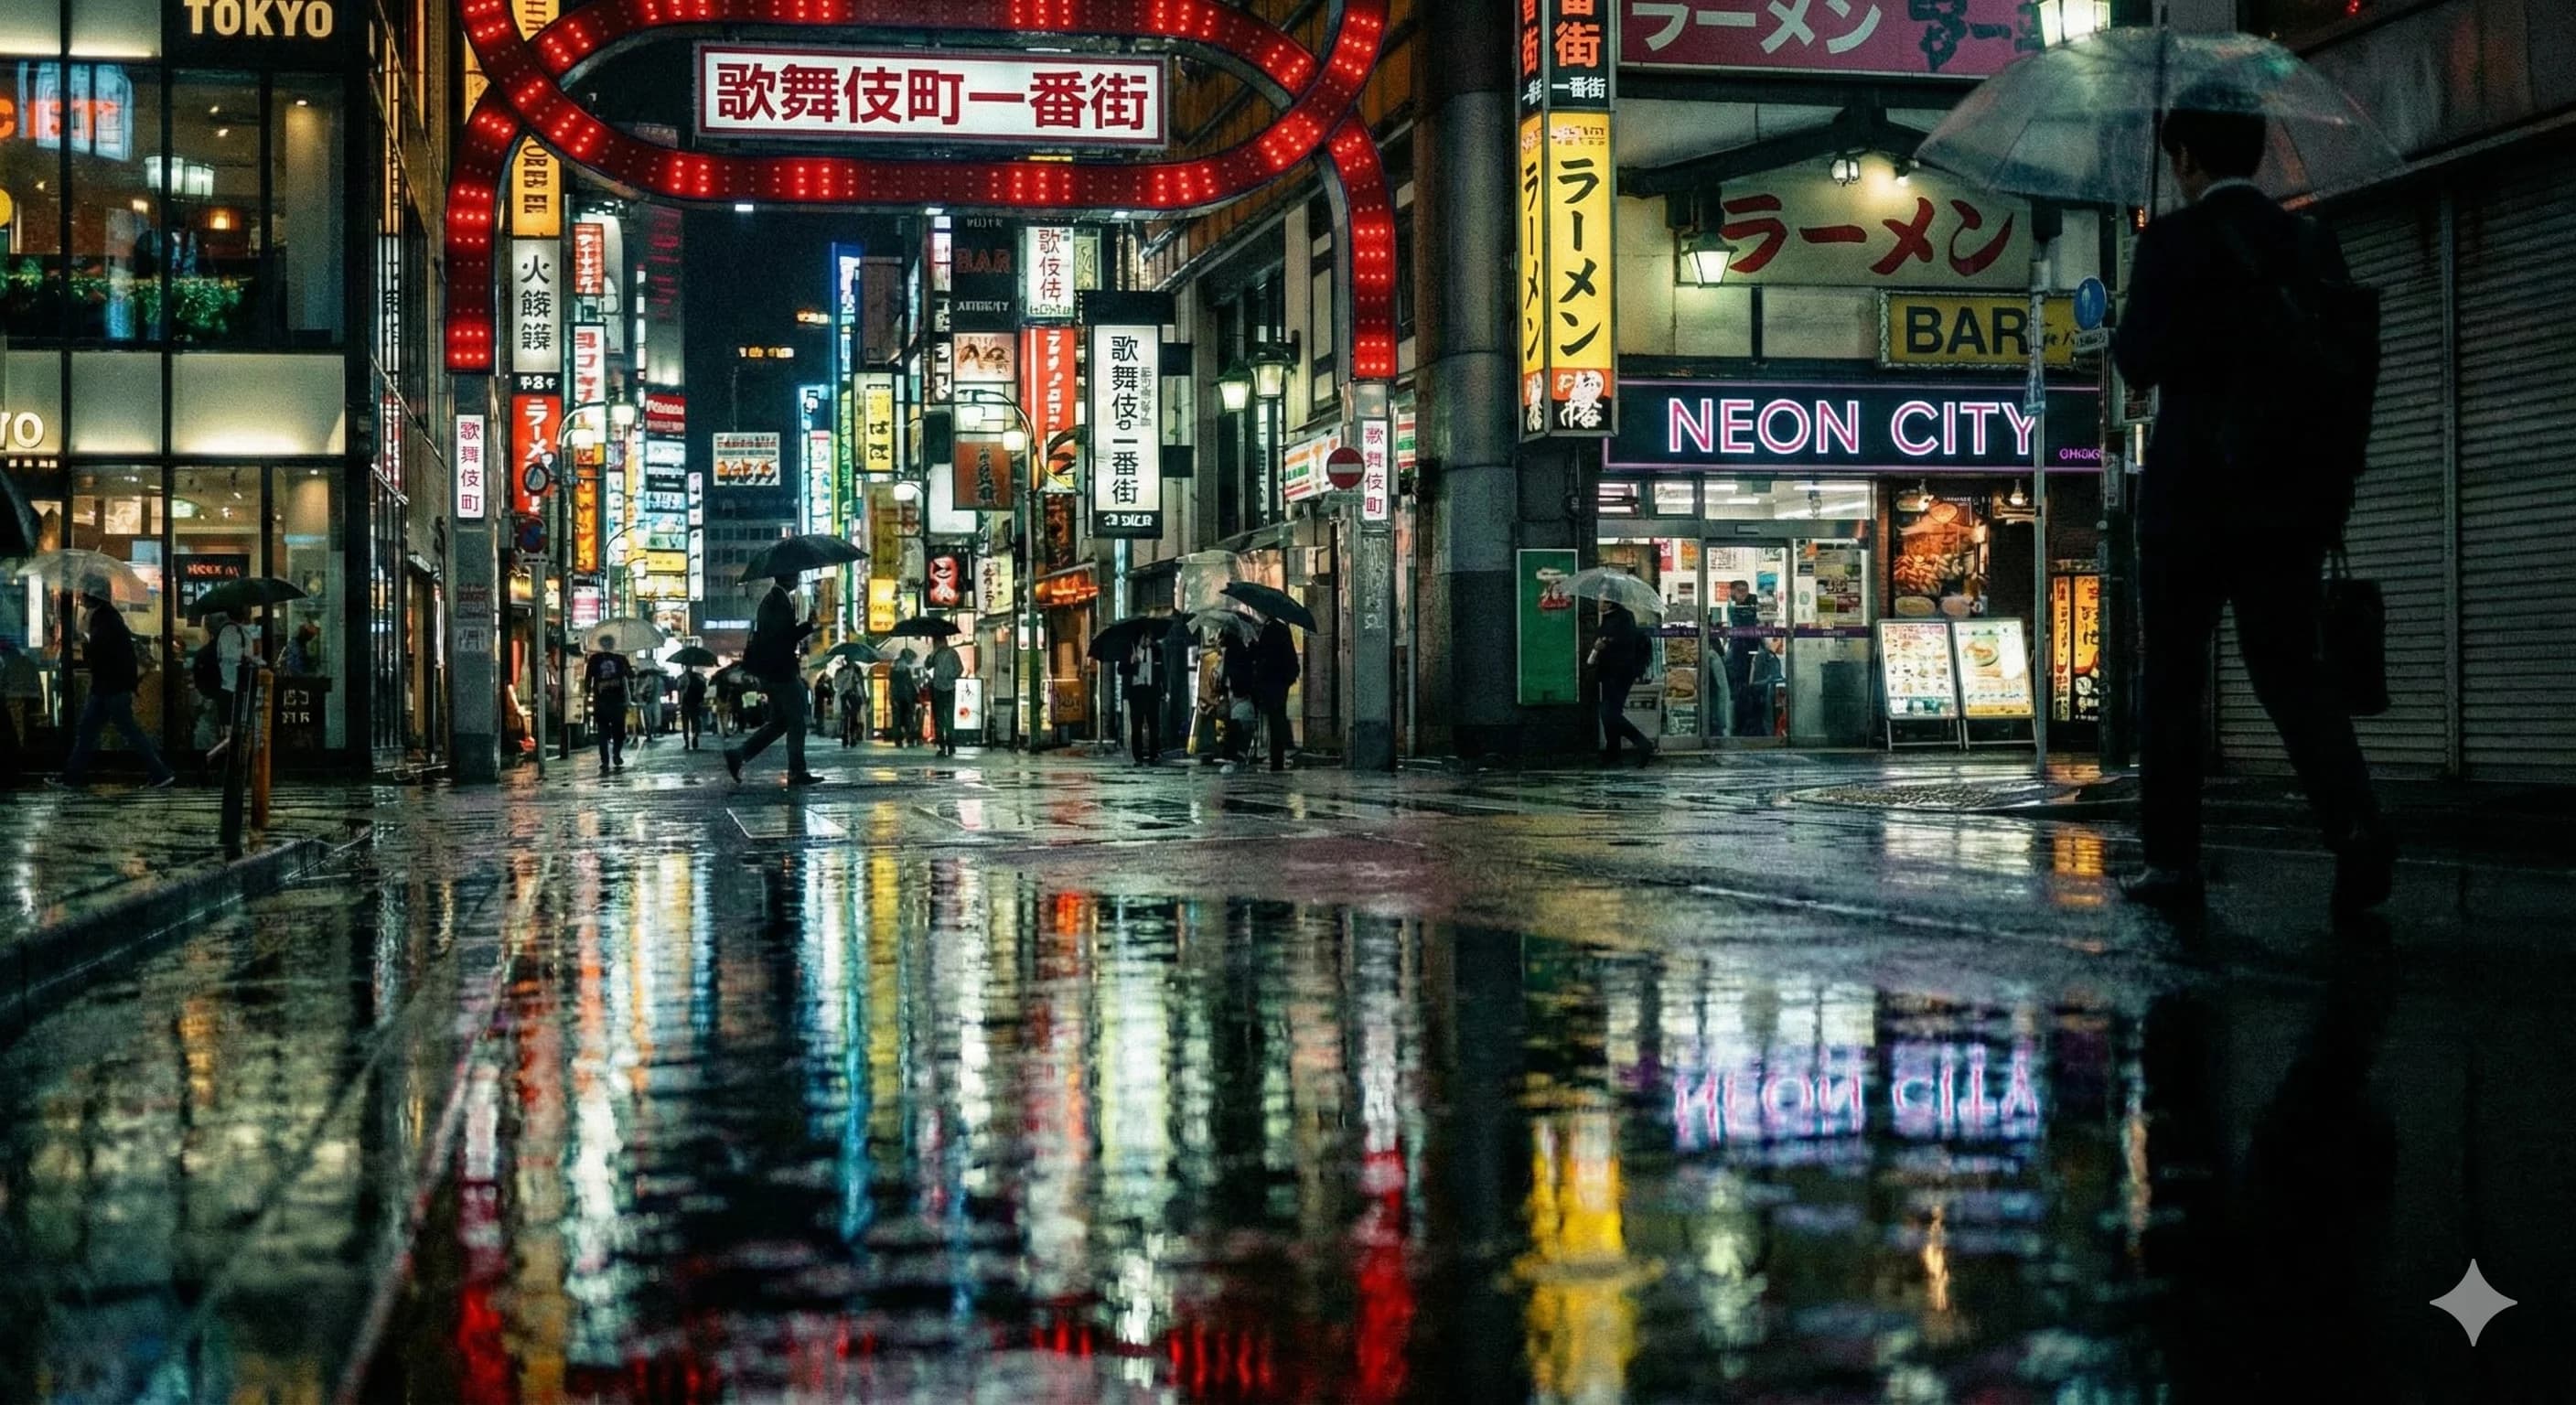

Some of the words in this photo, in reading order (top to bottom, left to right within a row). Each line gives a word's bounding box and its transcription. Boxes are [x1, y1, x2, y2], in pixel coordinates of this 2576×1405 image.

[186, 0, 333, 38] TOKYO
[1632, 0, 1882, 54] ラーメン
[716, 63, 1148, 130] 歌舞伎町一番街
[1551, 76, 1605, 99] 一番街
[1524, 162, 1540, 361] ラーメン
[1557, 158, 1600, 357] ラーメン
[1720, 194, 2013, 274] ラーメン
[1905, 306, 2030, 355] BAR
[1669, 398, 1859, 454] NEON
[1891, 400, 2036, 456] CITY
